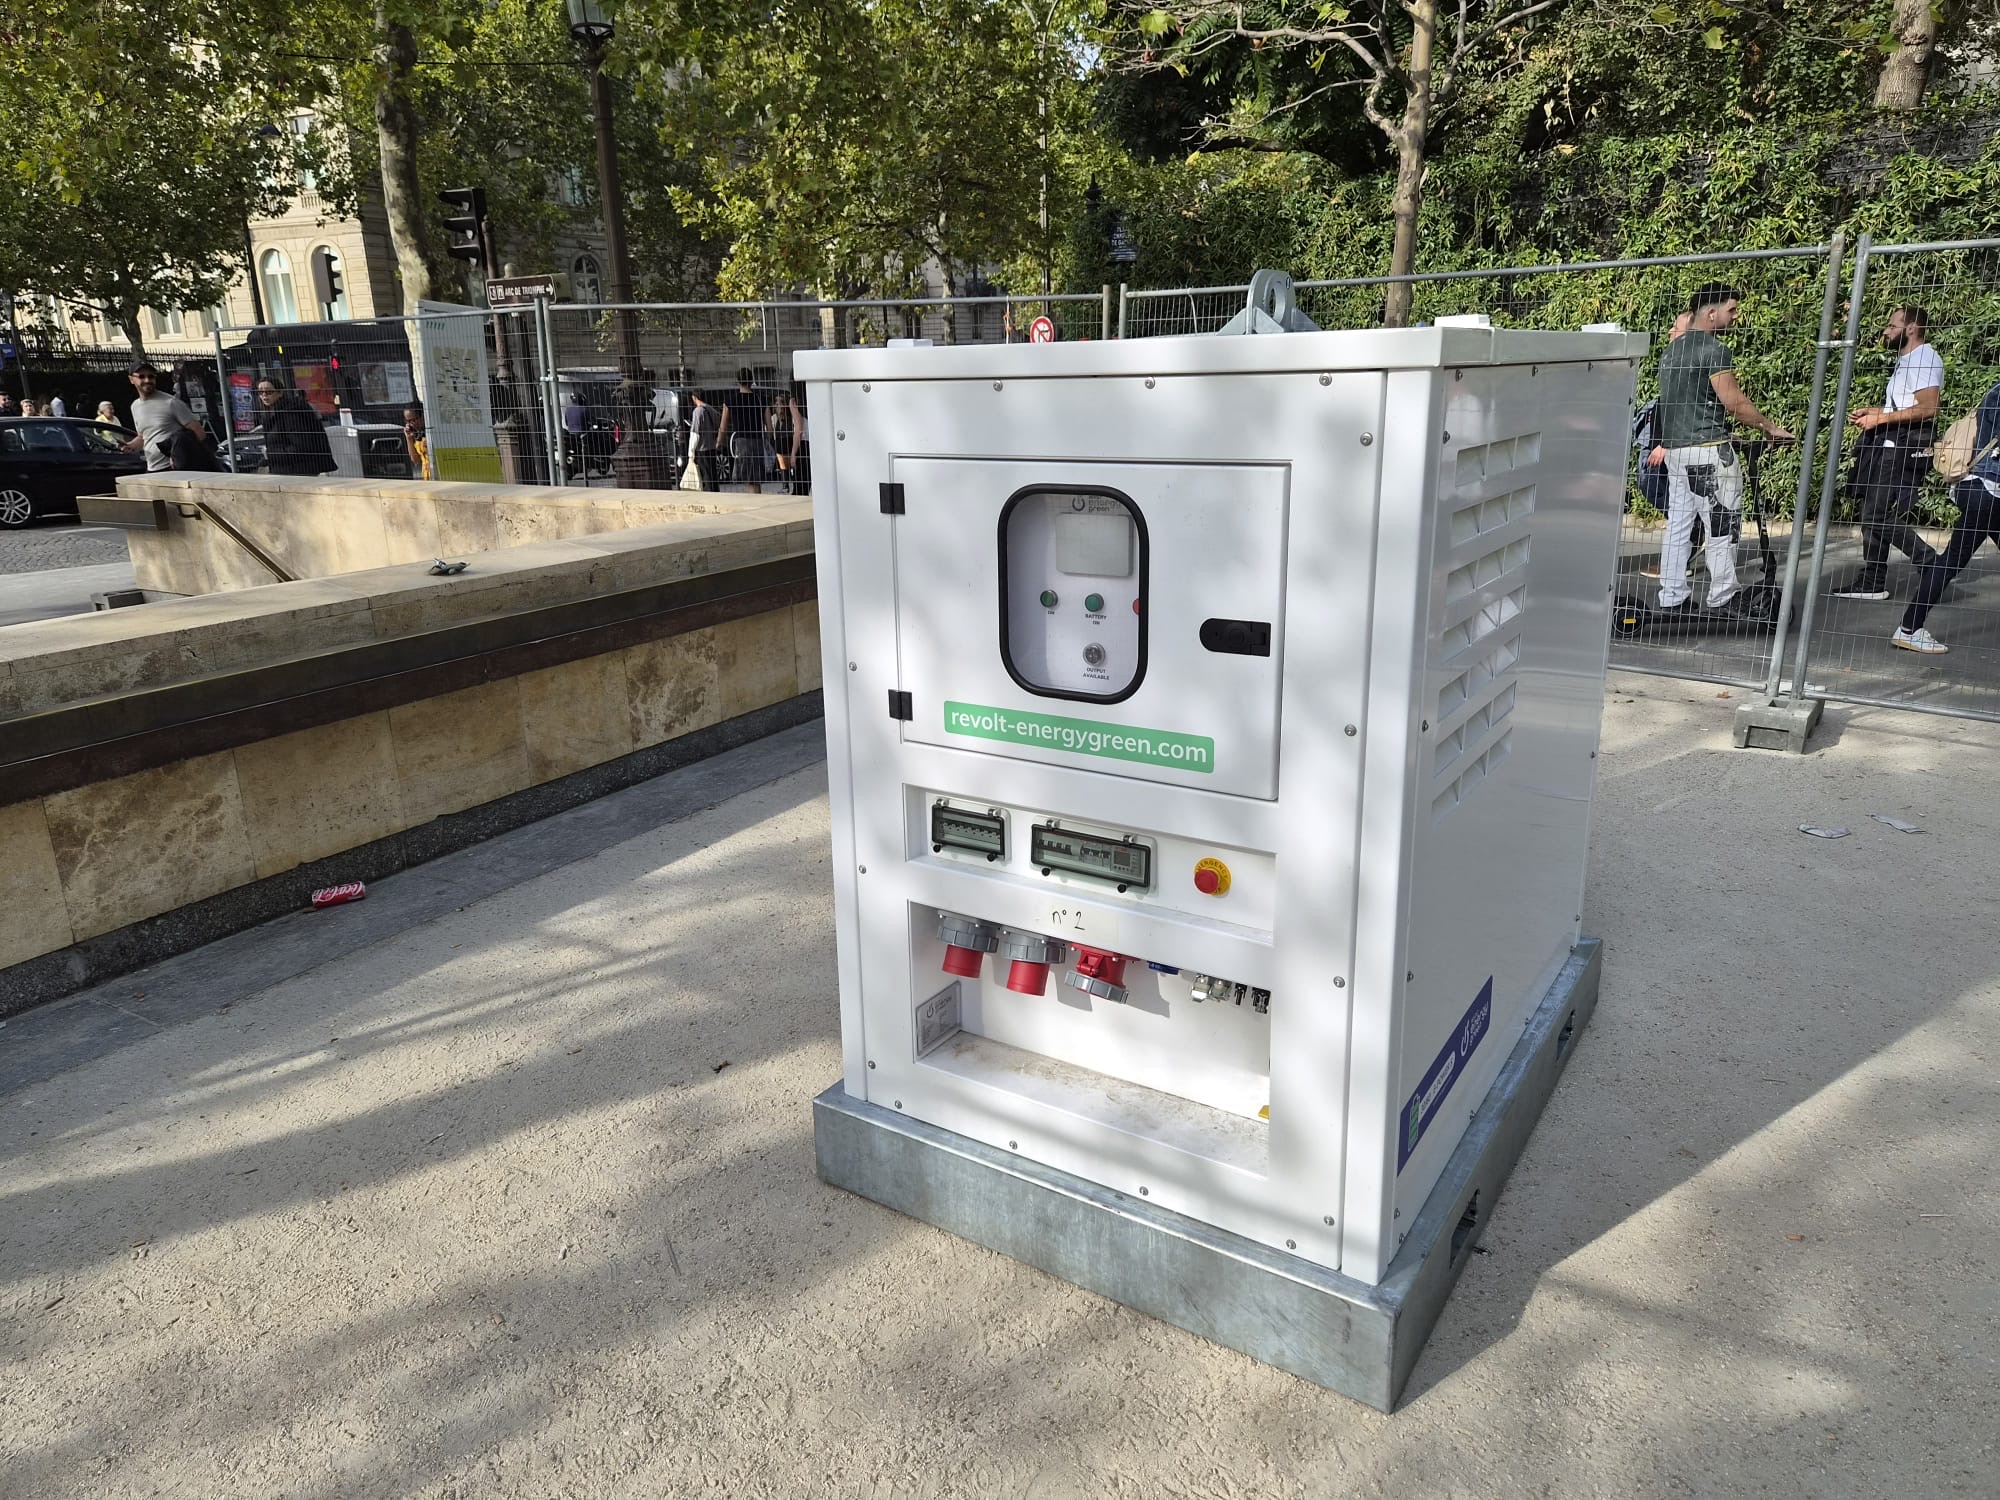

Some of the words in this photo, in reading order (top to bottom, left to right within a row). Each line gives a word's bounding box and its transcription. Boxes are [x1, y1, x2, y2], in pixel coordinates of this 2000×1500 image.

[505, 287, 514, 296] ARC
[514, 286, 521, 295] DE
[522, 285, 545, 295] TRIOMPHE
[1082, 672, 1110, 680] AVAILABLE
[951, 709, 1207, 763] revolt-energygreen.com
[1052, 909, 1067, 925] n°
[1074, 911, 1086, 931] 2
